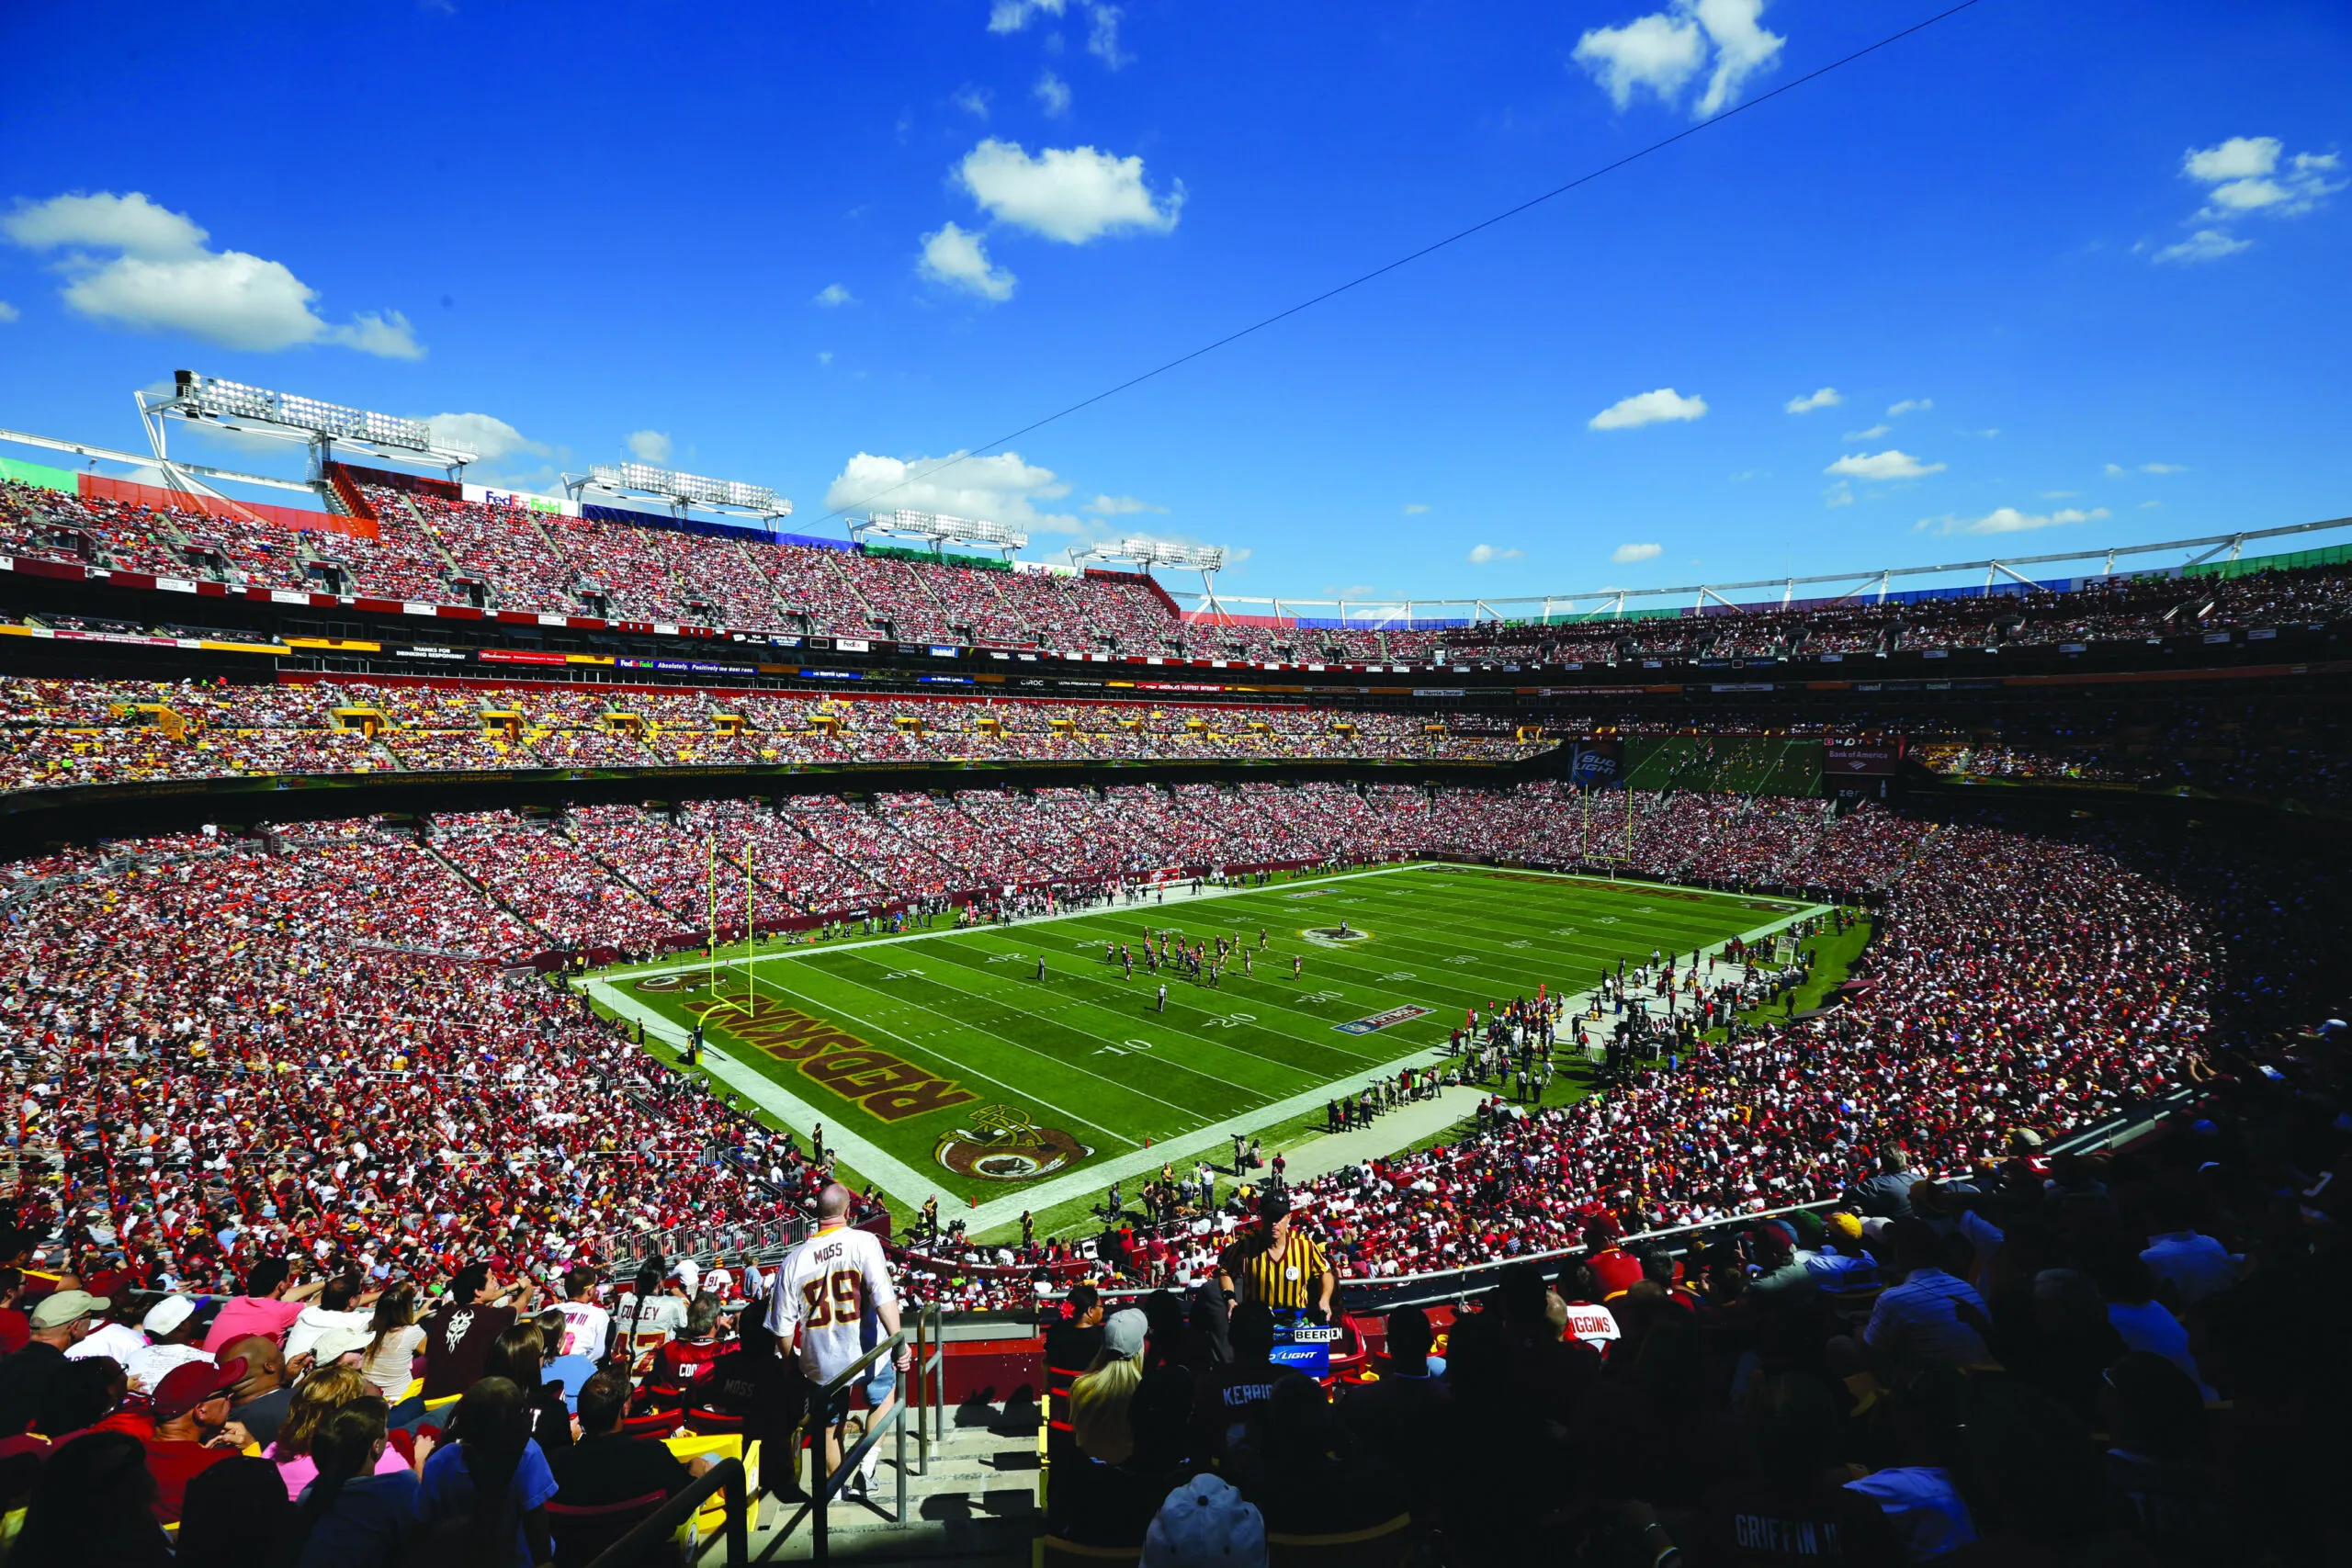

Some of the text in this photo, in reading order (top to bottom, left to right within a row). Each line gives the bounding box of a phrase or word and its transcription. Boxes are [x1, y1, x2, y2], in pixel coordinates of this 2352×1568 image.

[620, 659, 654, 668] FedExField
[692, 664, 718, 672] Positively
[1573, 762, 1617, 775] LIGHT
[1581, 755, 1617, 768] BUD
[1482, 873, 1713, 901] REDSKINS
[1300, 990, 1343, 1003] 30
[1208, 1013, 1257, 1028] 20
[1102, 1039, 1152, 1056] 10
[681, 993, 984, 1123] REDSKINS
[813, 1243, 842, 1265] MOSS
[802, 1269, 862, 1330] 89
[621, 1304, 660, 1320] COLEY
[1568, 1316, 1611, 1333] IGGINS
[1295, 1330, 1328, 1339] BEER
[1282, 1351, 1317, 1359] LIGHT
[723, 1379, 755, 1397] MOSS
[1735, 1514, 1817, 1555] GRIFFIN
